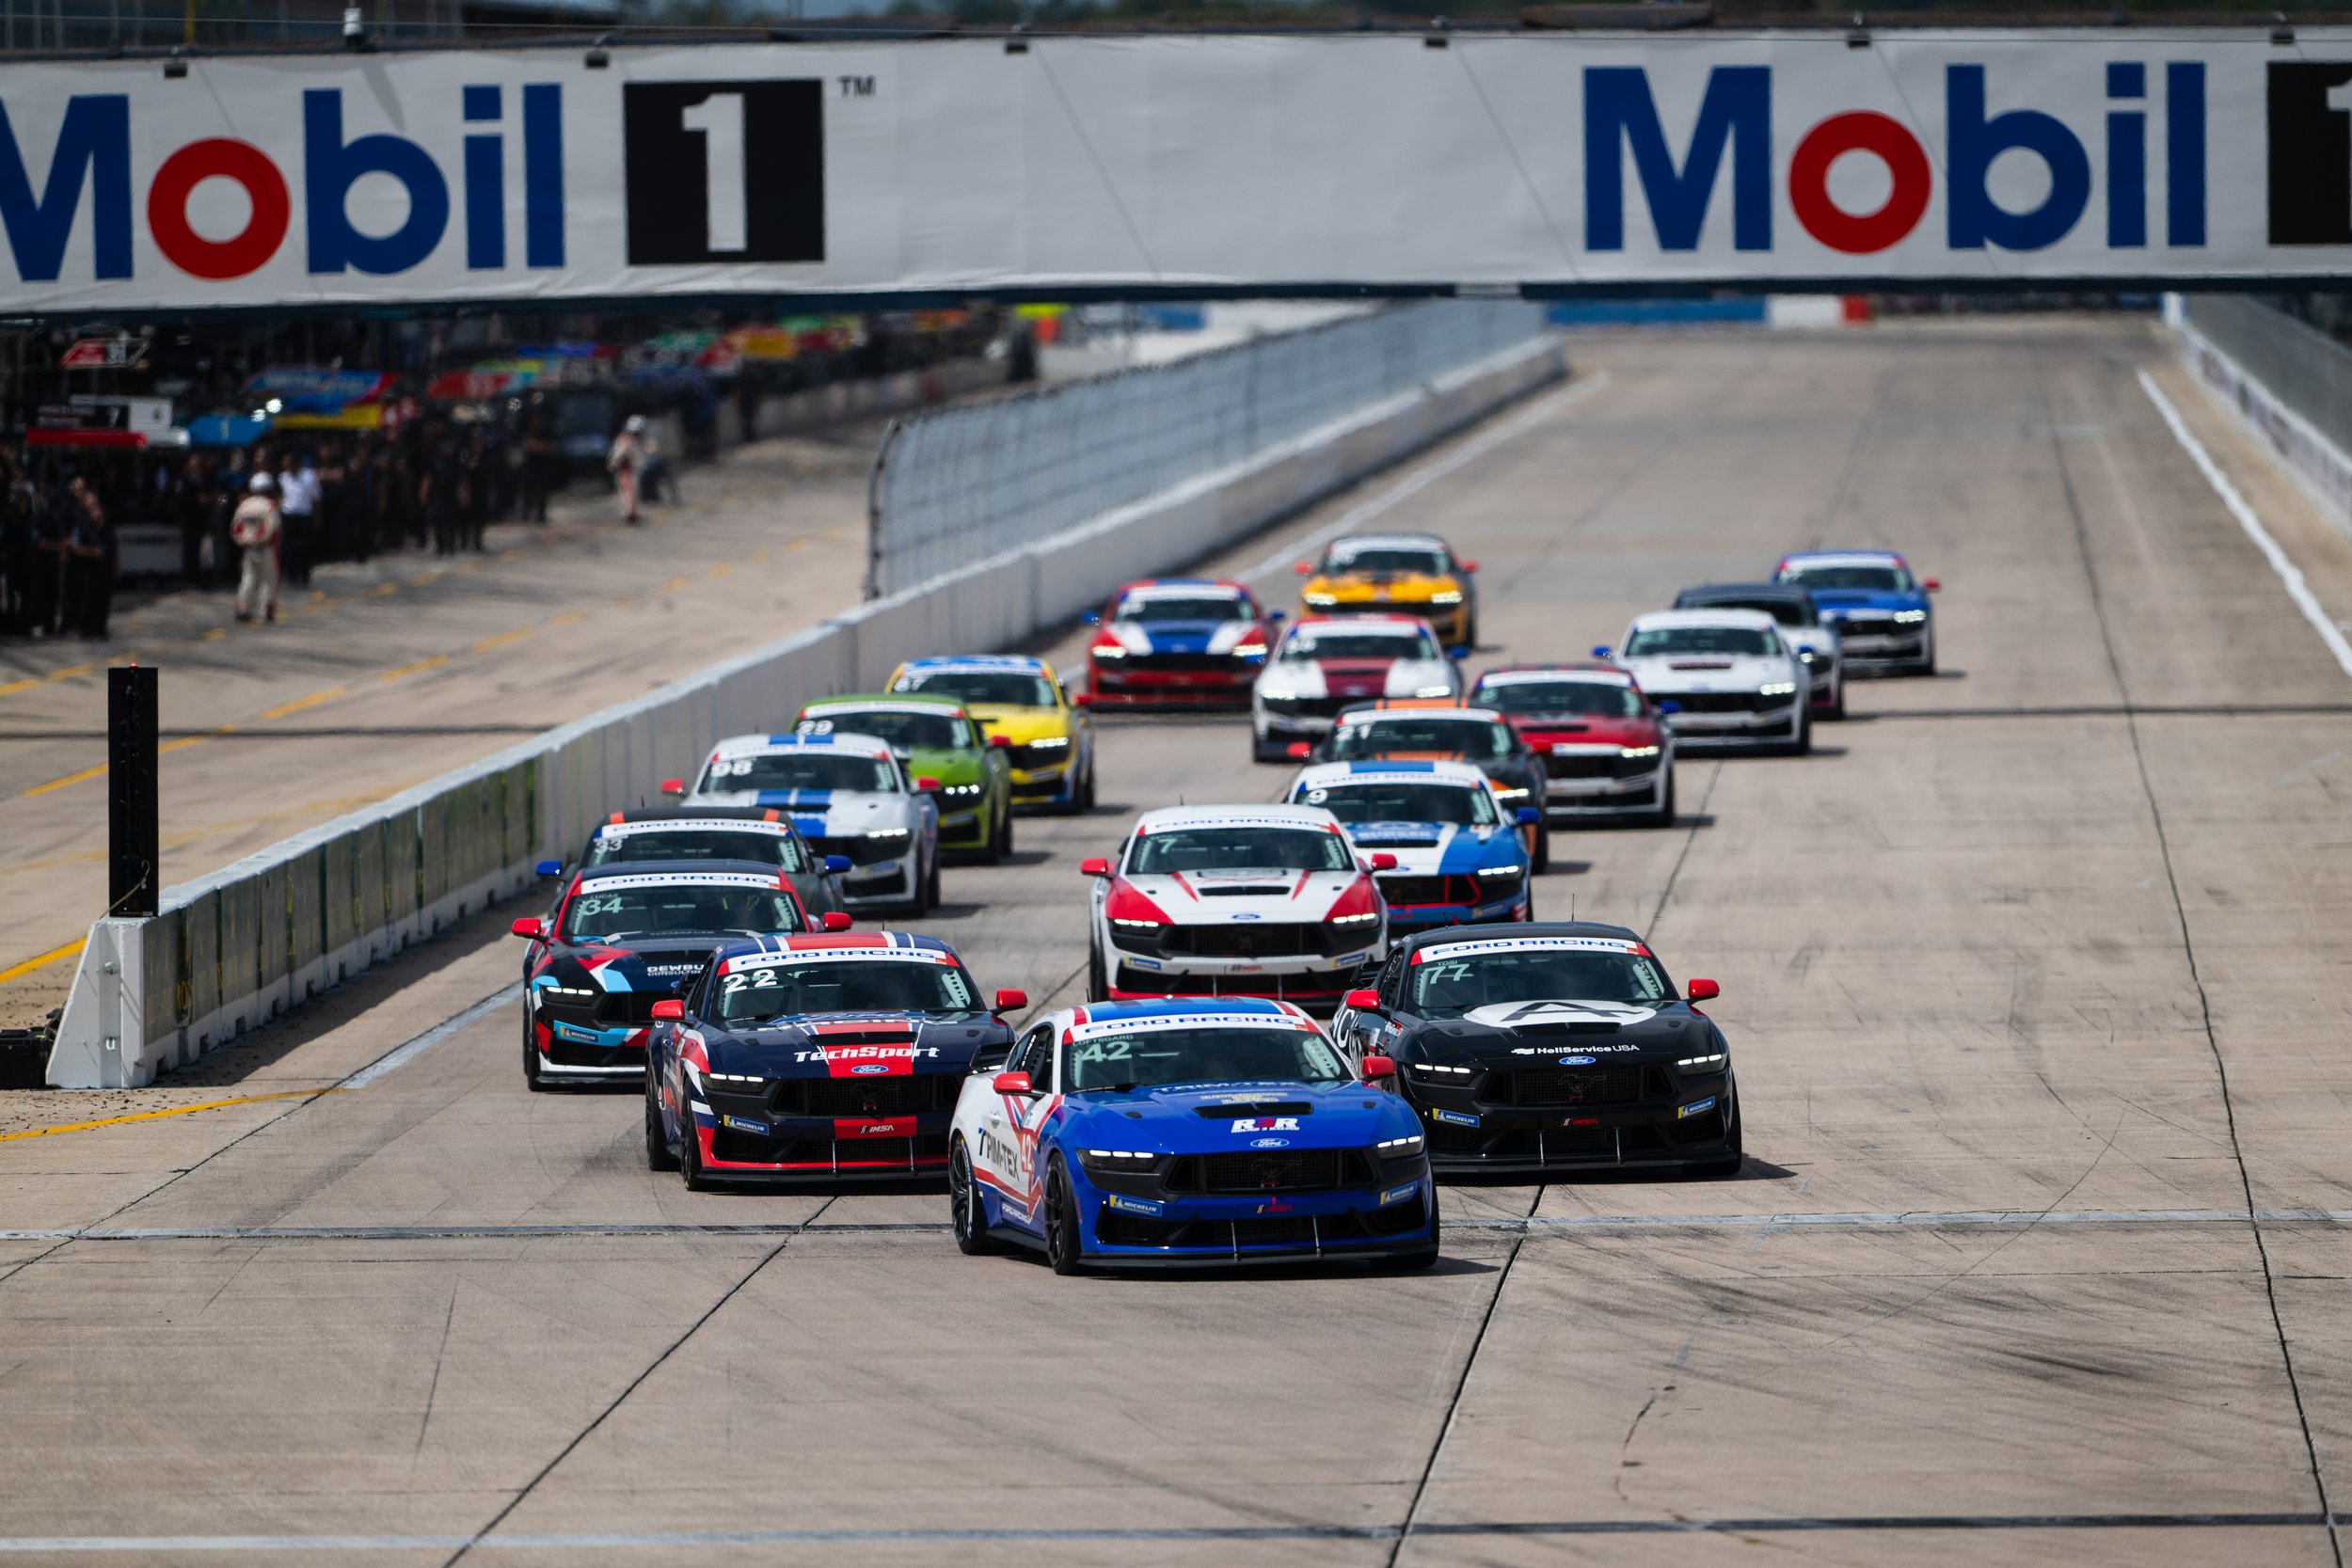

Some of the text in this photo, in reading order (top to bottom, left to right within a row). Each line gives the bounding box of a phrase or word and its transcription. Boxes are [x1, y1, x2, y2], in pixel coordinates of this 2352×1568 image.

[1582, 61, 2206, 254] Mobil
[0, 82, 565, 282] Mobil
[681, 92, 747, 252] 1
[1309, 787, 1328, 804] 9
[1155, 818, 1320, 829] FORD RACING
[594, 837, 623, 854] 33
[1157, 838, 1177, 854] 7
[592, 875, 771, 887] FORD RACING
[580, 896, 624, 916] 34
[1433, 939, 1627, 955] FORD RACING
[740, 949, 935, 965] FORD RACING
[723, 969, 778, 994] 22
[1424, 963, 1470, 985] 77
[1084, 1016, 1295, 1034] FORD RACING
[793, 1046, 940, 1063] TechSport
[1081, 1040, 1133, 1063] 42
[736, 1120, 765, 1132] MICHELIN
[1445, 1114, 1475, 1125] MICHELIN
[1572, 1117, 1598, 1126] IMSA
[869, 1124, 895, 1133] IMSA
[1021, 1132, 1033, 1172] 42
[1122, 1200, 1158, 1212] MICHELIN
